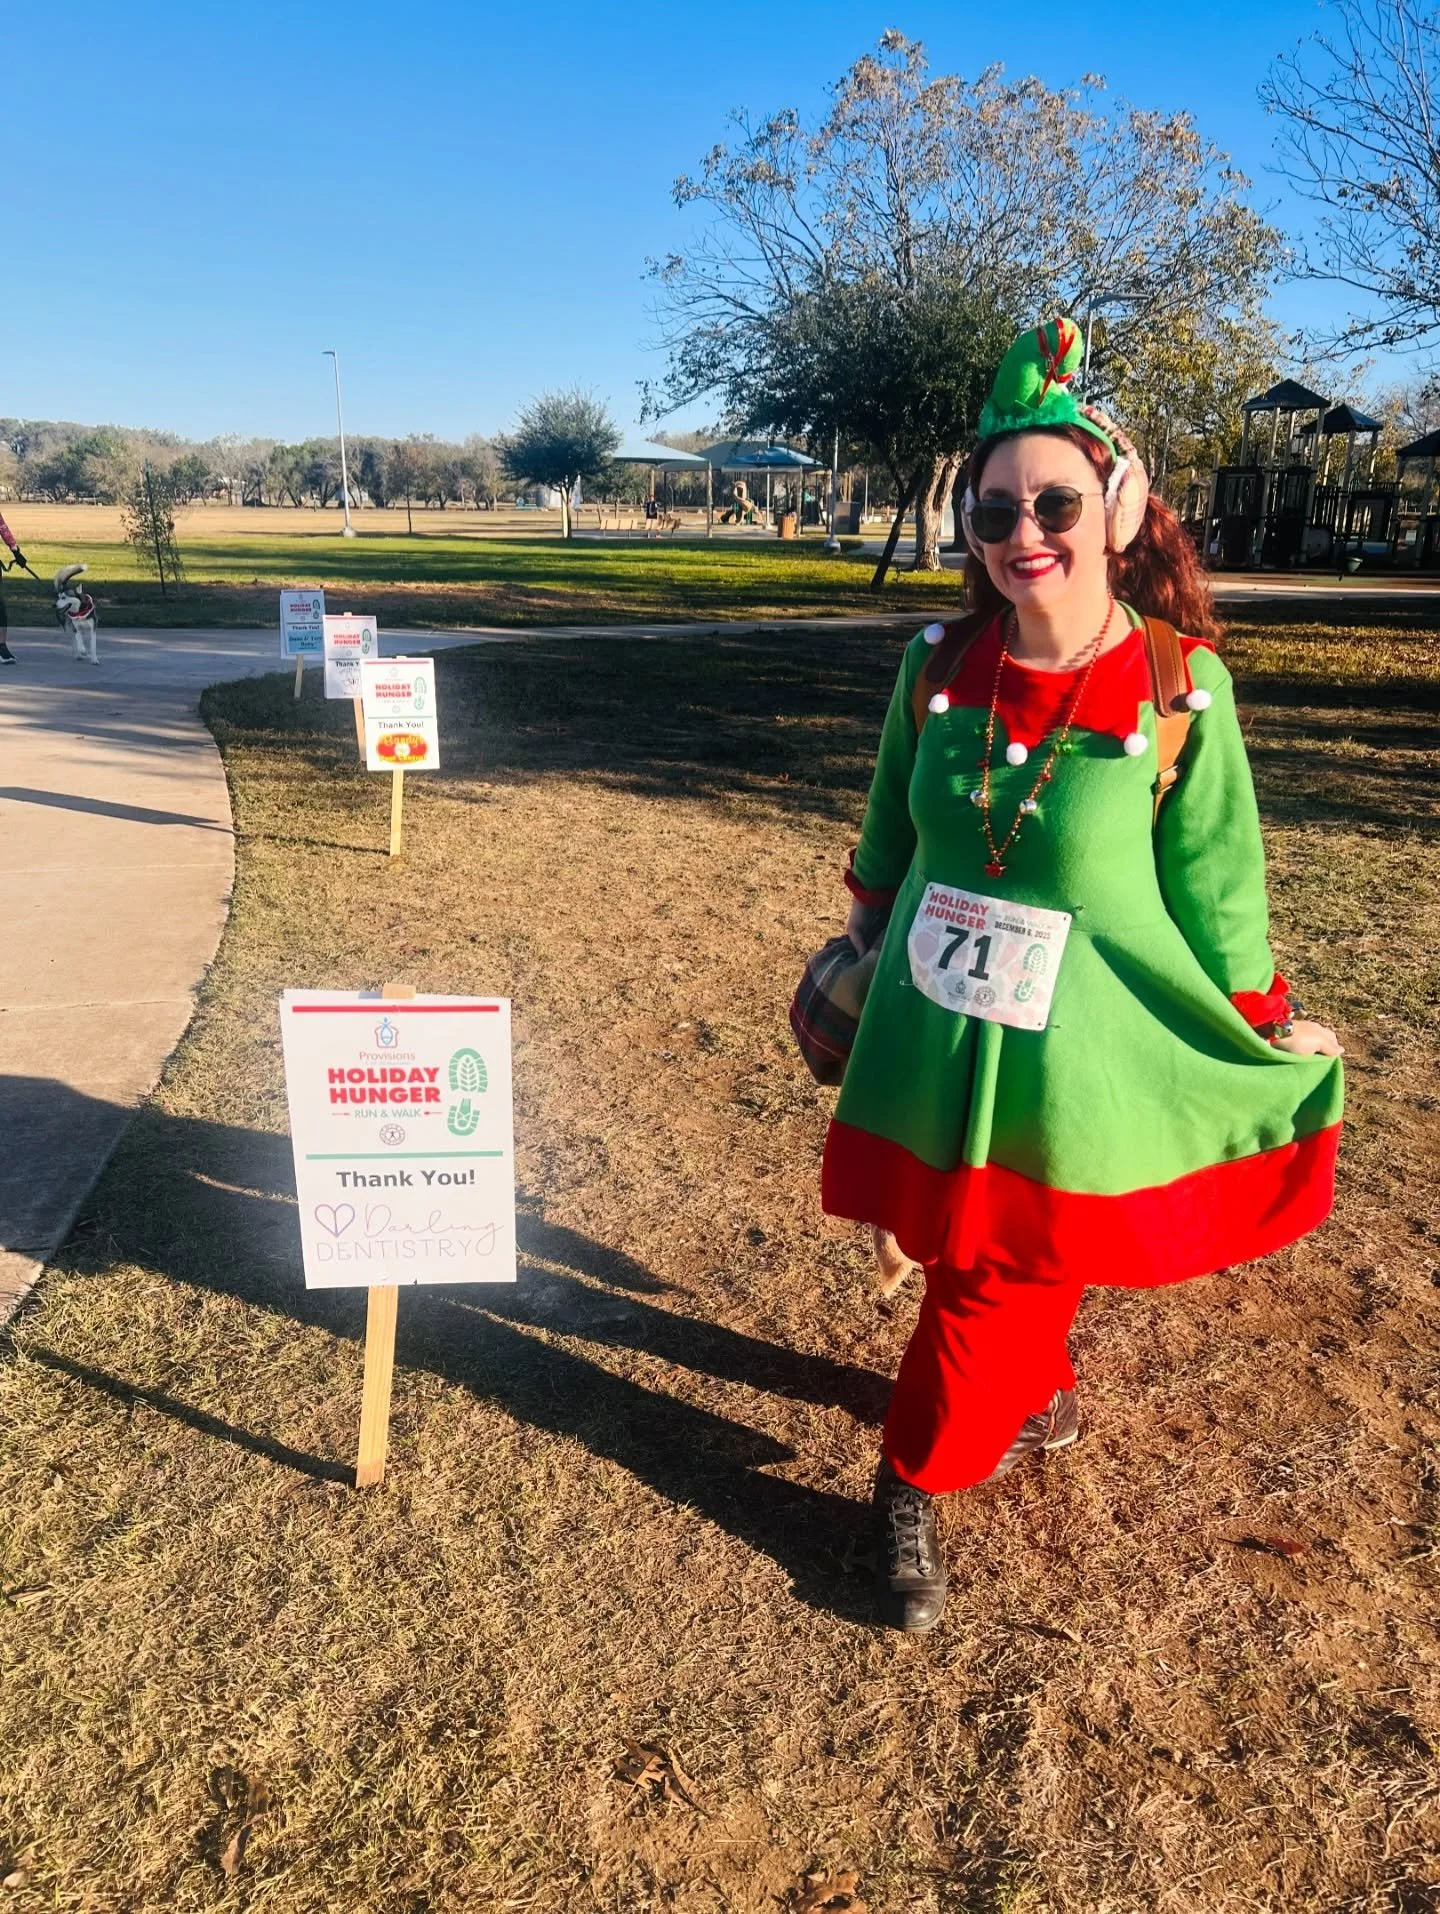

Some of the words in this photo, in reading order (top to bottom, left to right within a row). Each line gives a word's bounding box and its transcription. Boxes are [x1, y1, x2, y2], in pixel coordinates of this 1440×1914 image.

[378, 721, 405, 729] Thank
[406, 720, 425, 729] You!
[929, 891, 990, 917] HOLIDAY
[925, 904, 986, 931] HUNGER
[994, 920, 1026, 935] DECEMBER
[938, 925, 992, 981] 71
[359, 1051, 416, 1061] Provisions
[328, 1067, 440, 1084] HOLIDAY
[329, 1086, 441, 1104] HUNGER
[354, 1109, 378, 1118] RUN
[380, 1109, 389, 1118] &
[390, 1108, 421, 1118] WALK
[336, 1170, 414, 1188] Thank
[420, 1169, 476, 1186] You!
[363, 1202, 505, 1257] Darling
[316, 1238, 472, 1263] DENTISTRY
